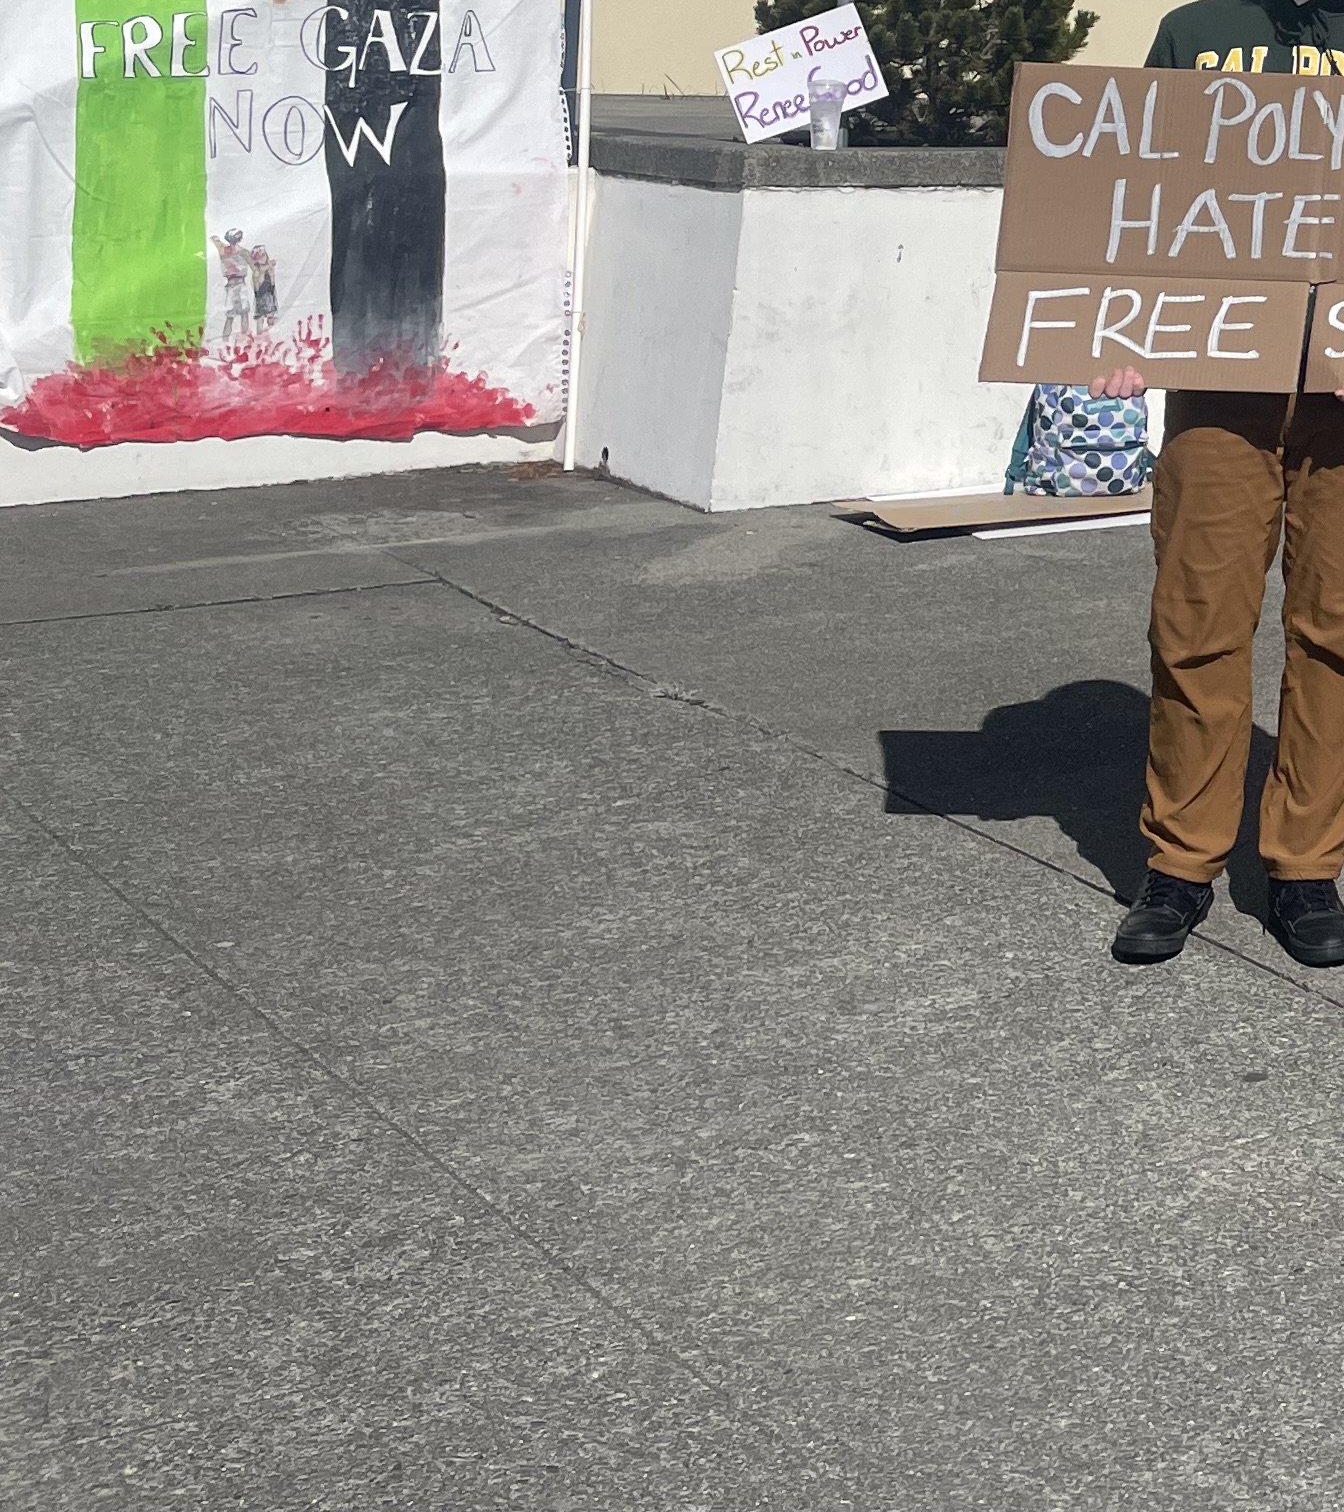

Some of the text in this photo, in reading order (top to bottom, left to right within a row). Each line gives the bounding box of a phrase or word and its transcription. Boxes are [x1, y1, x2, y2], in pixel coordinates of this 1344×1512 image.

[78, 5, 495, 89] FREE GAZA
[721, 25, 862, 85] Rest in Power
[209, 89, 410, 168] NOW
[734, 90, 811, 130] Renee
[1028, 78, 1180, 159] CAL
[1016, 287, 1267, 367] FREE
